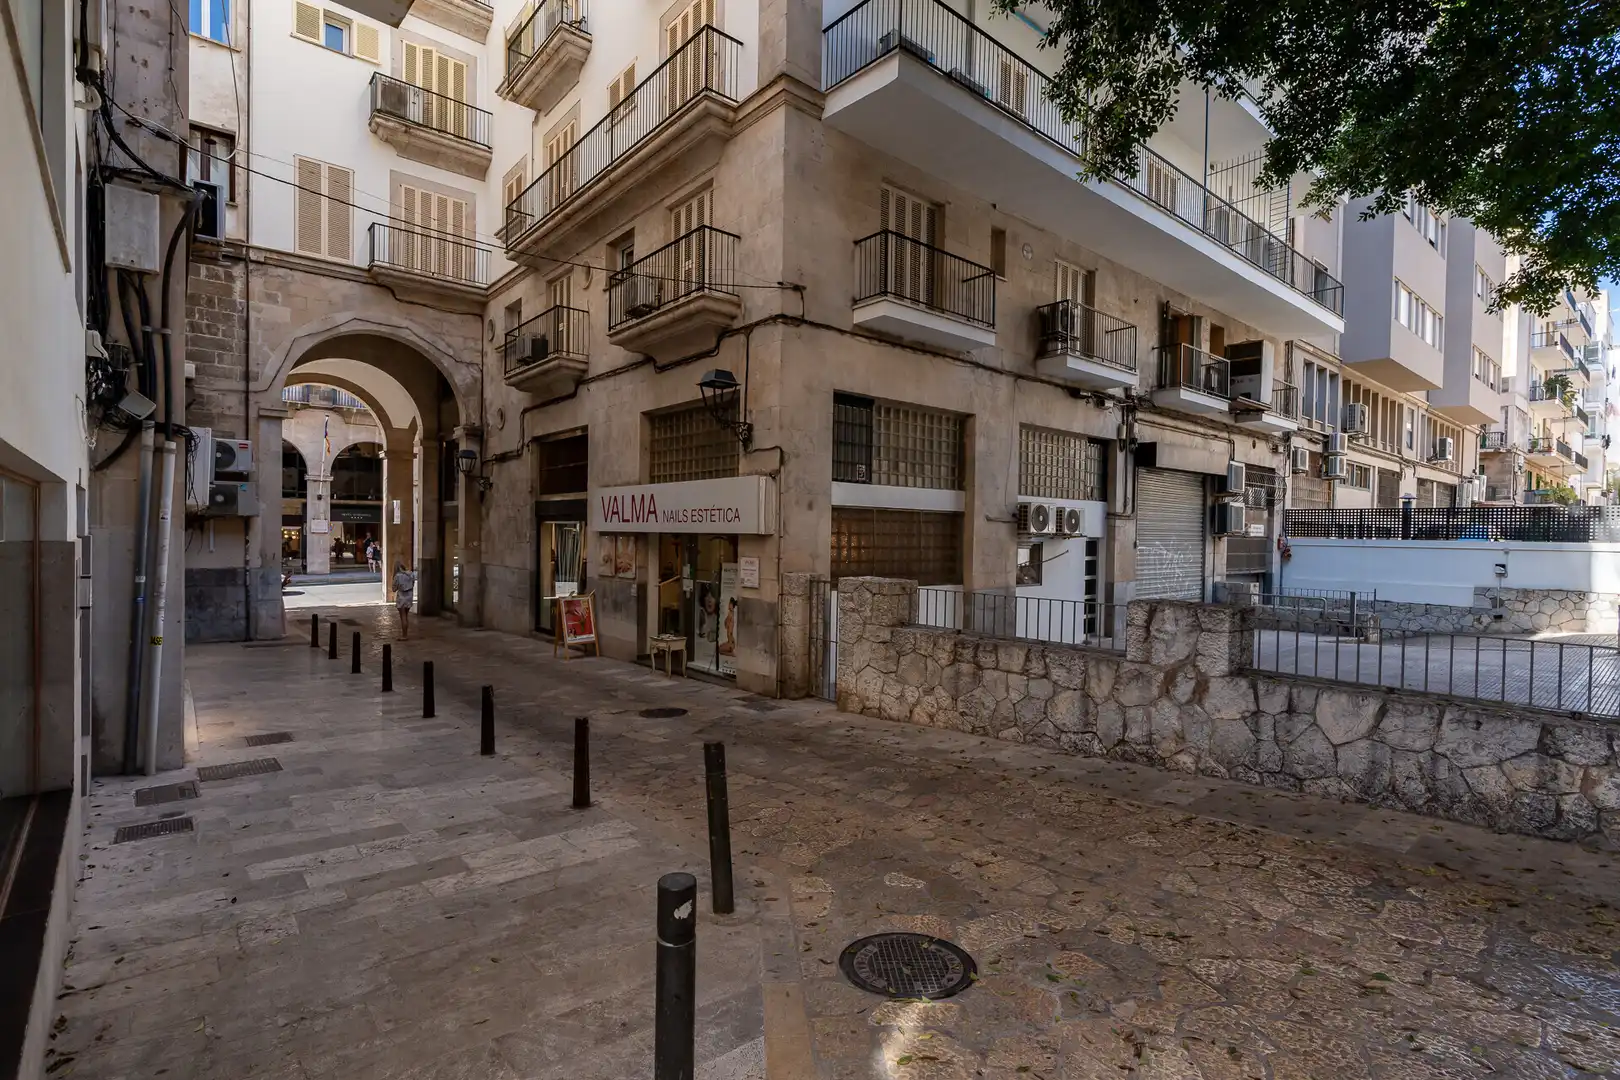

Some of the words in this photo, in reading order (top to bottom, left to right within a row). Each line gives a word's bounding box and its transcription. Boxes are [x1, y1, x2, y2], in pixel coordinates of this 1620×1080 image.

[601, 494, 658, 523] VALMA
[662, 509, 689, 523] NAILS
[691, 505, 741, 523] ESTÉTICA
